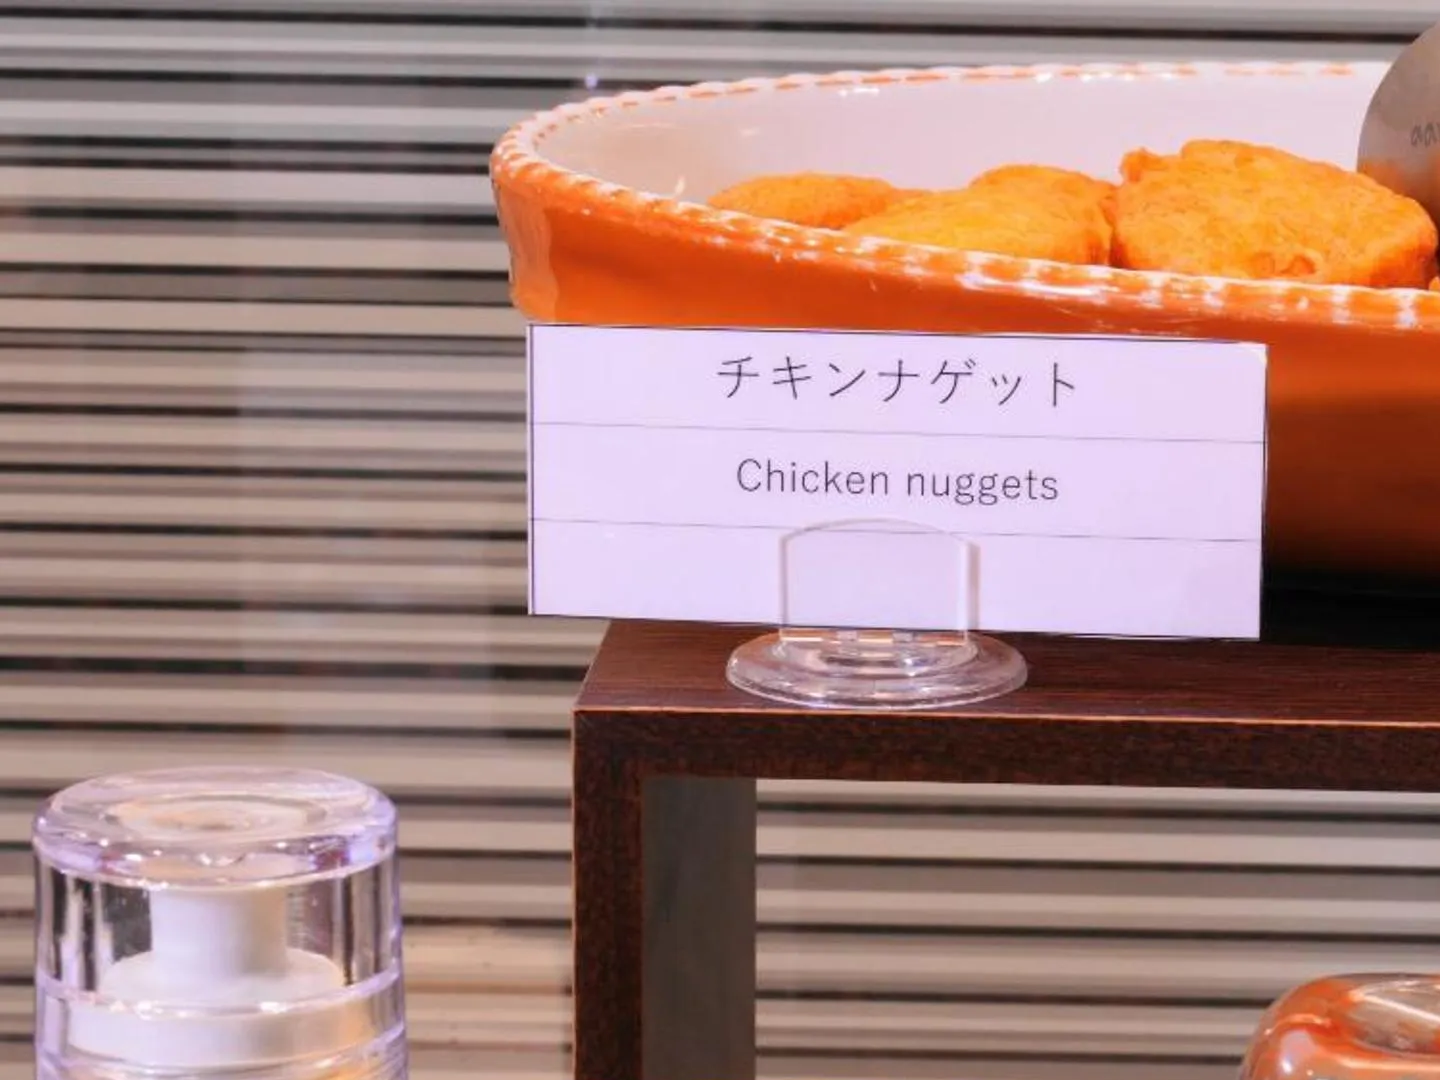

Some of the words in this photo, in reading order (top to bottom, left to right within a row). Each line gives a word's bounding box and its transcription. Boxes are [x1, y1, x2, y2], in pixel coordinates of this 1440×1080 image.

[717, 355, 1076, 407] チキンナゲット
[736, 458, 889, 496] Chicken
[906, 468, 1059, 505] nuggets
